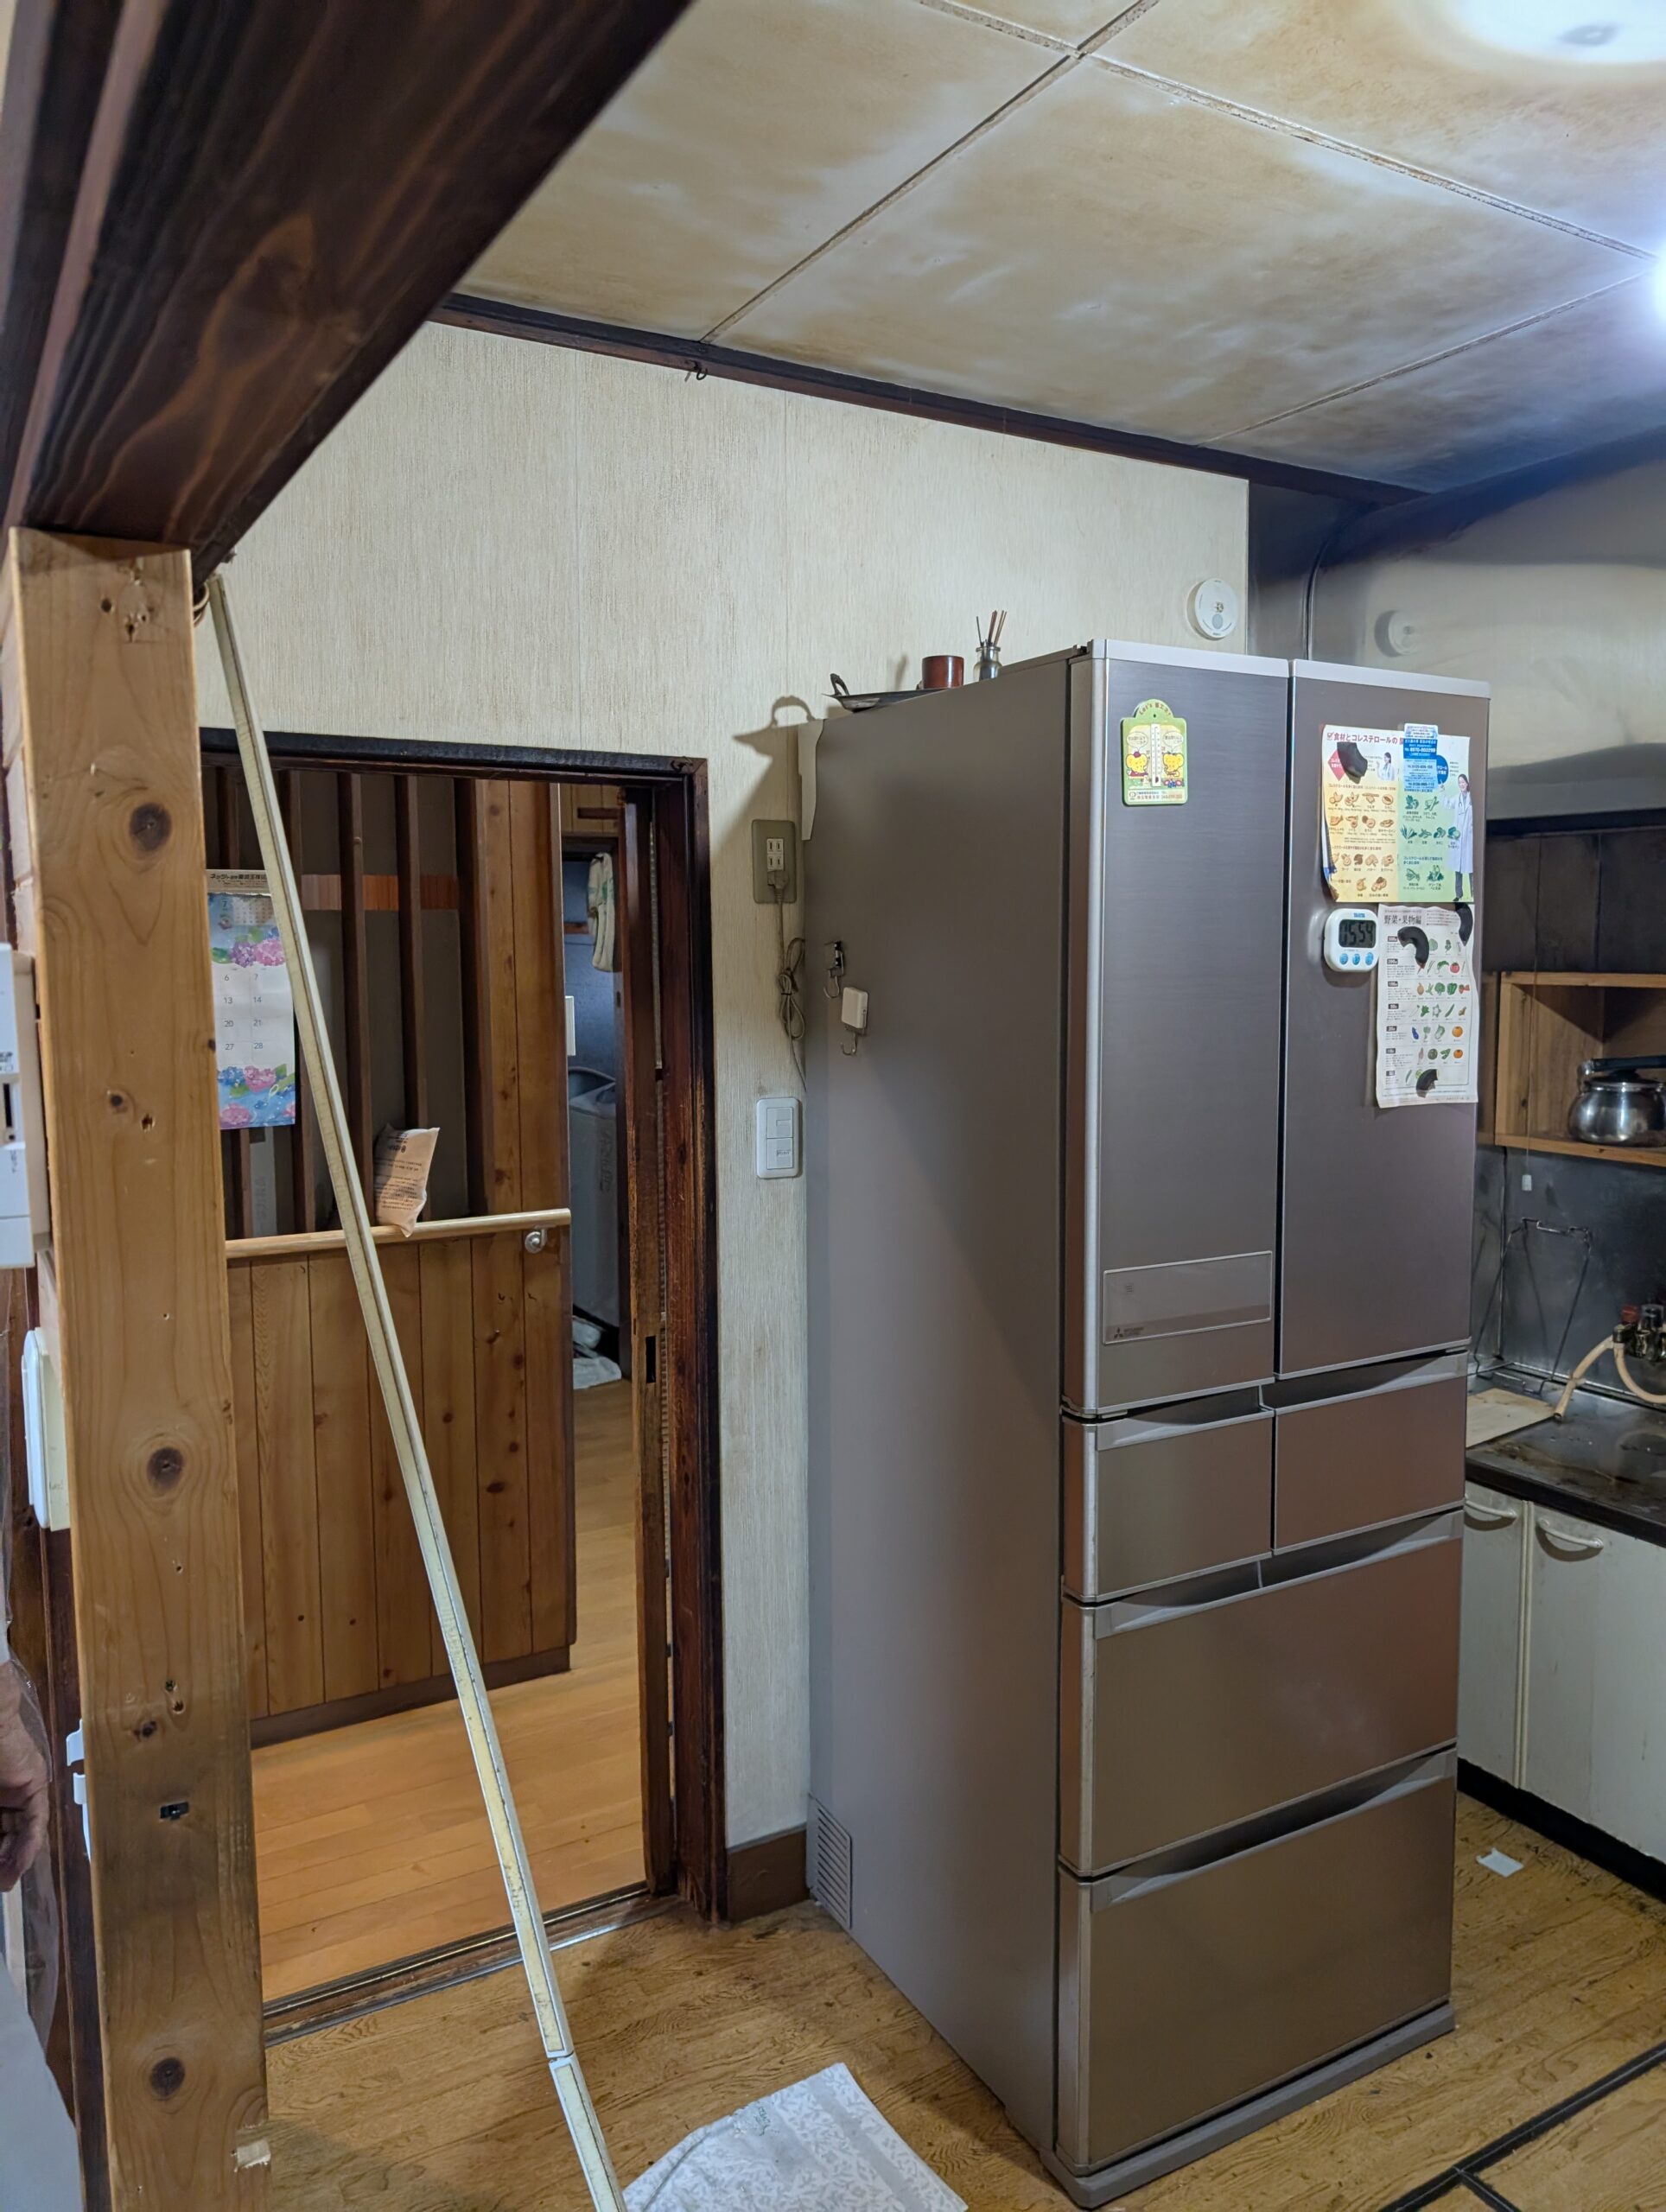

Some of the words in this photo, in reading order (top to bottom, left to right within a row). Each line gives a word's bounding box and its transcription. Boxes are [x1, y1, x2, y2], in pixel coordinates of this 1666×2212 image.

[1384, 915, 1421, 925] 野菜・果物編
